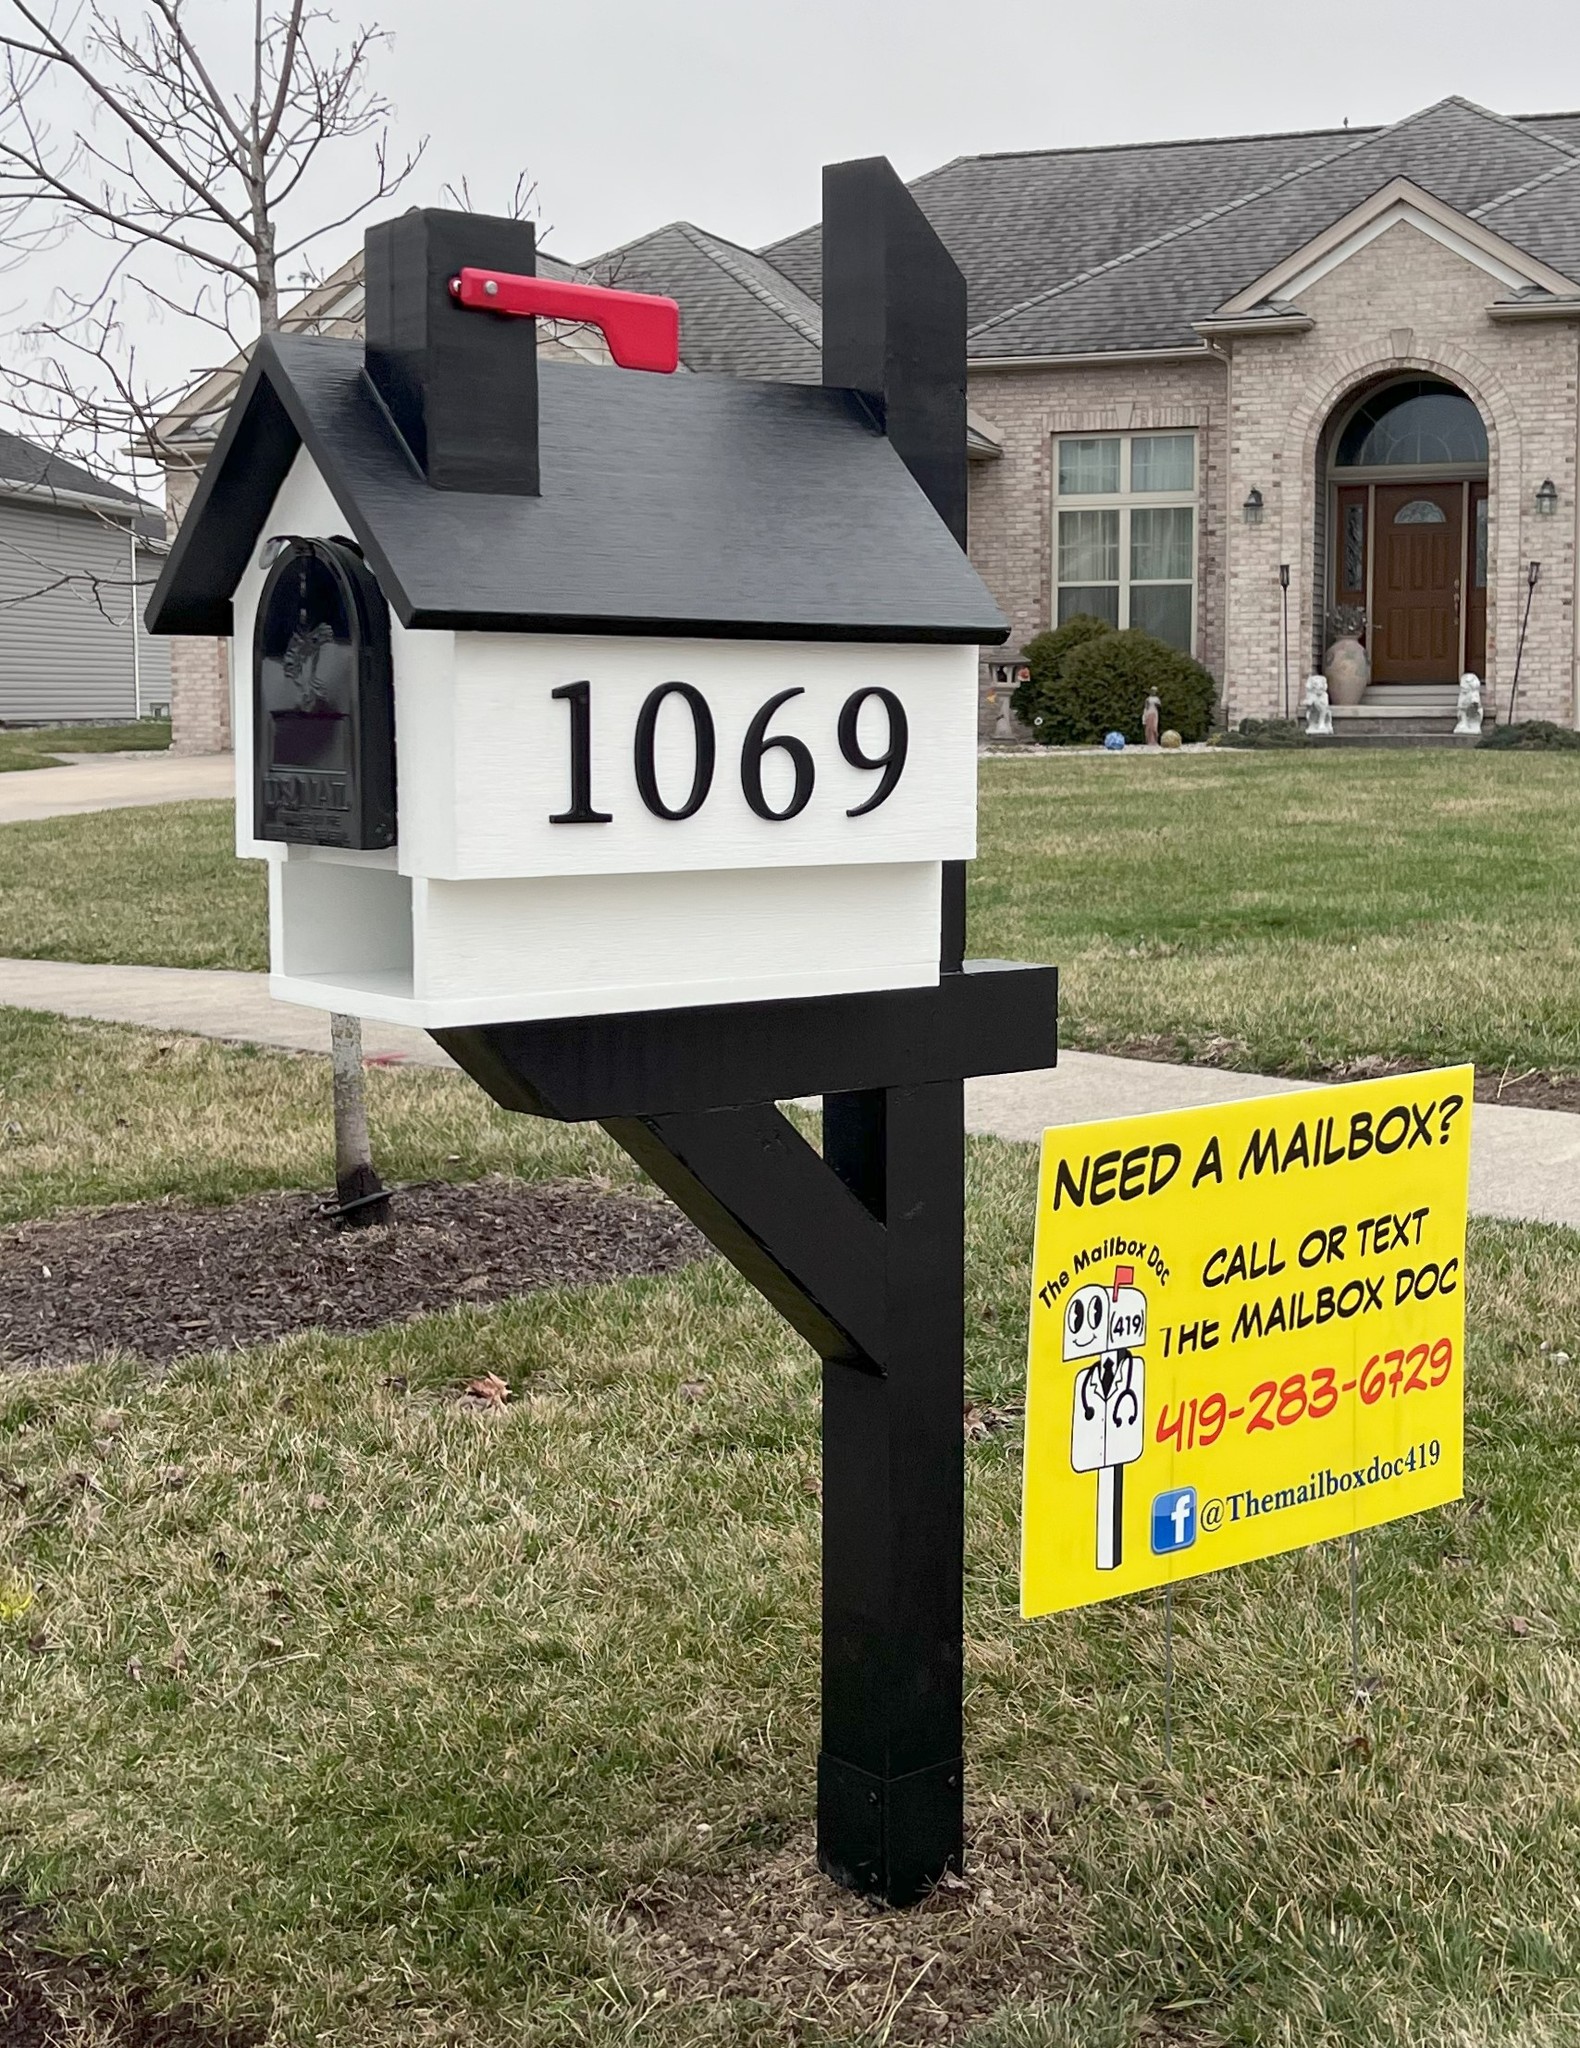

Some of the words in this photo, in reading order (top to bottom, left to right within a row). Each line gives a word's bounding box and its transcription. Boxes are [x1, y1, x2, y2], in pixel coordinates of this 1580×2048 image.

[549, 680, 909, 823] 1069
[1053, 1143, 1182, 1211] NEED
[1192, 1135, 1222, 1188] A
[1238, 1094, 1464, 1181] MAILBOX?
[1038, 1271, 1070, 1309] The
[1073, 1236, 1147, 1275] Mailbox
[1147, 1245, 1170, 1286] Doc
[1202, 1238, 1286, 1288] CALL
[1298, 1225, 1347, 1268] OR
[1357, 1207, 1430, 1257] TEXT
[1110, 1309, 1145, 1343] (419)
[1159, 1320, 1220, 1358] THE
[1231, 1275, 1385, 1344] MAILBOX
[1394, 1257, 1458, 1306] DOC
[1156, 1337, 1452, 1452] 419-283-6729
[1200, 1439, 1440, 1532] @Themailboxdoc419
